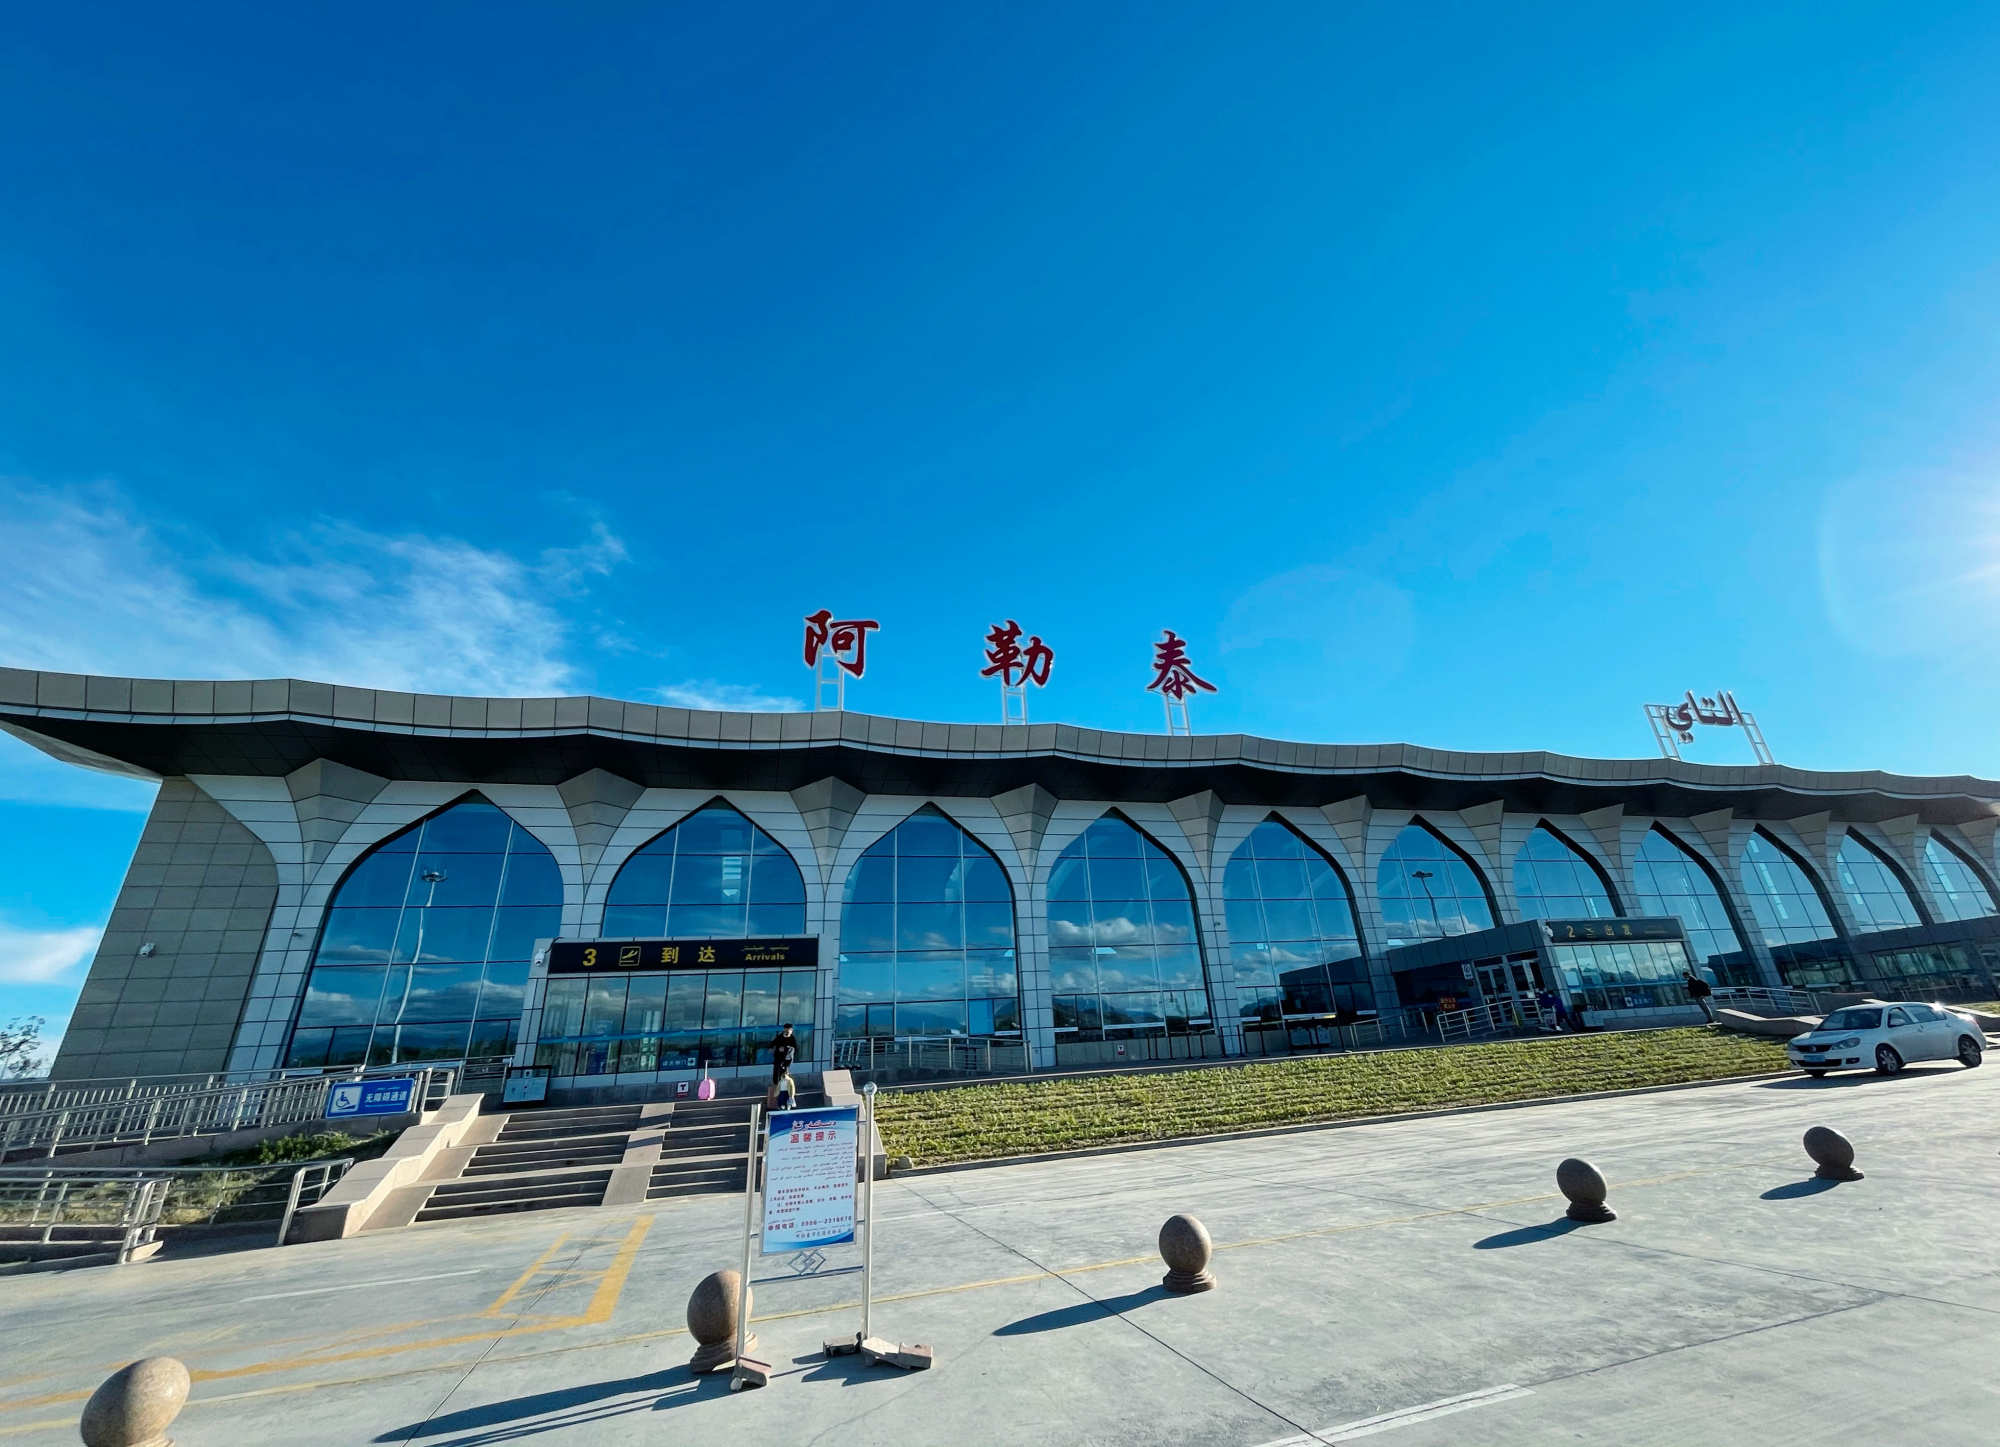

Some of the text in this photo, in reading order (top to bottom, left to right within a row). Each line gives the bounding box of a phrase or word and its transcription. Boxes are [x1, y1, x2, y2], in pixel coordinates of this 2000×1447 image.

[803, 609, 1218, 700] 阿勒泰
[1566, 925, 1576, 938] 2
[1604, 923, 1633, 937] 出发
[582, 946, 716, 967] 3 到达
[744, 953, 785, 961] Arrivals
[364, 1090, 408, 1103] 无障碍通道
[790, 1131, 837, 1143] 温馨提示
